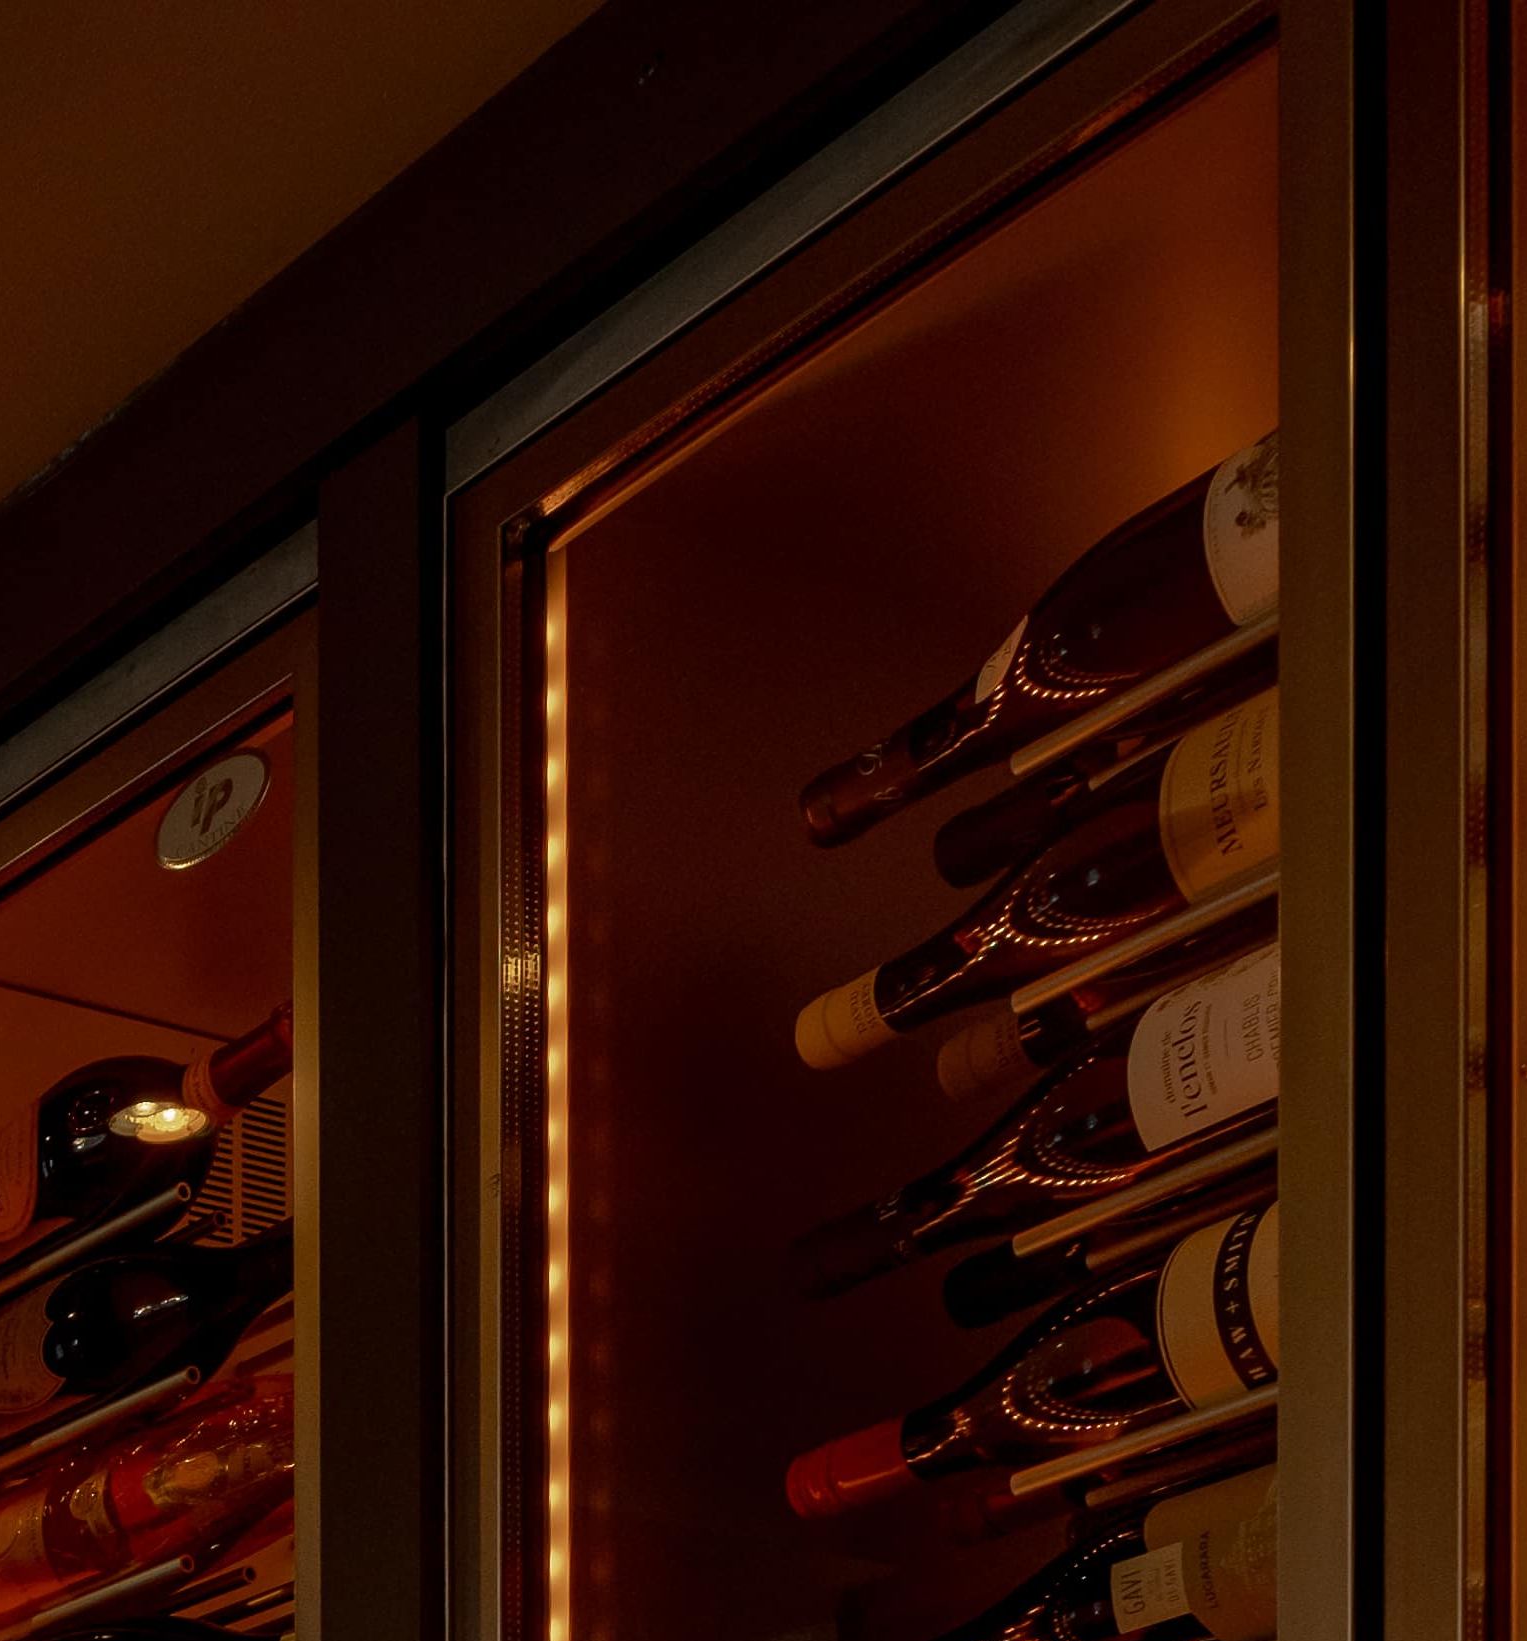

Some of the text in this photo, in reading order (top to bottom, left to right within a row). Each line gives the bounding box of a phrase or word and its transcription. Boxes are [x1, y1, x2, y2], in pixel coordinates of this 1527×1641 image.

[1172, 1000, 1208, 1119] l'enclos
[1241, 994, 1264, 1062] CHABLIS
[1160, 1047, 1176, 1104] domaine
[1222, 1213, 1258, 1292] SMITH
[1119, 1569, 1146, 1615] GAVI
